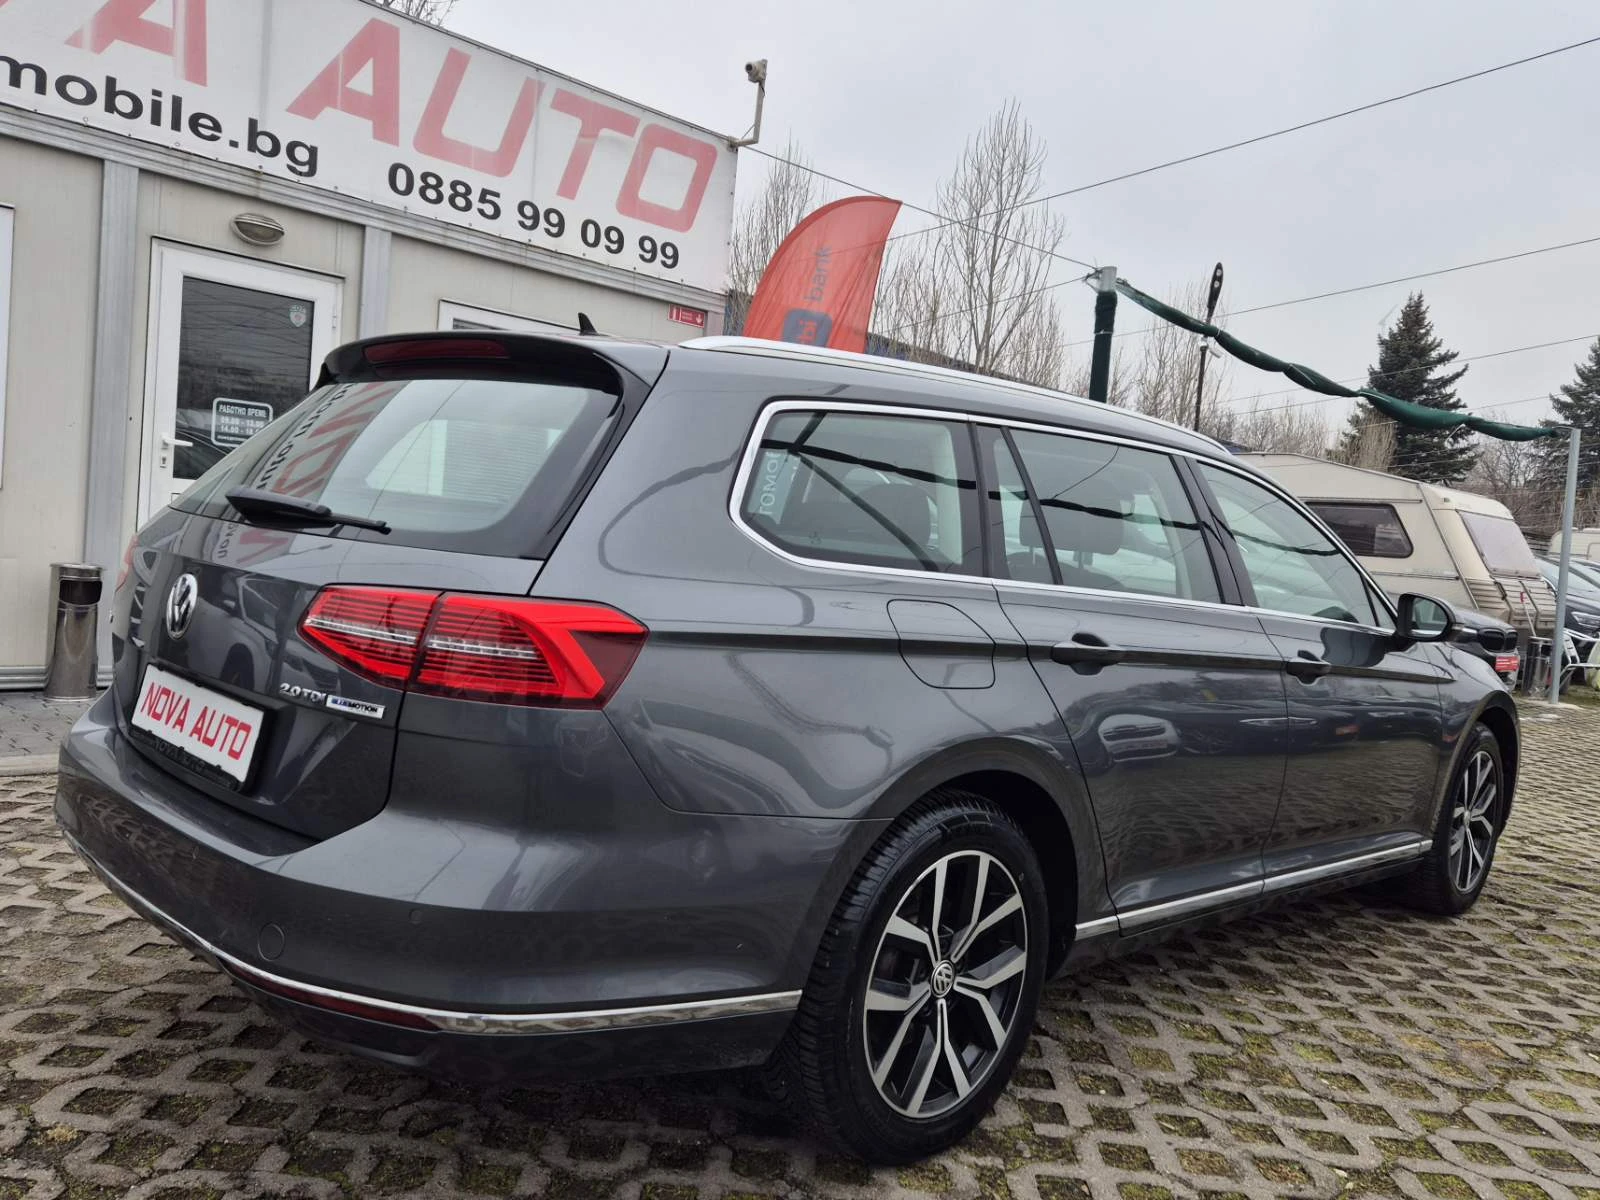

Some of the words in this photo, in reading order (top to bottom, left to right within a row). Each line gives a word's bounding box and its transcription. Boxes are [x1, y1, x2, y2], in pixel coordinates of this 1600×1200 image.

[286, 17, 718, 234] AUTO
[387, 162, 502, 221] 0885
[516, 200, 566, 238] 99
[580, 218, 625, 255] 09
[638, 235, 680, 270] 99
[140, 682, 191, 733] NOVA
[188, 706, 252, 760] AUTO
